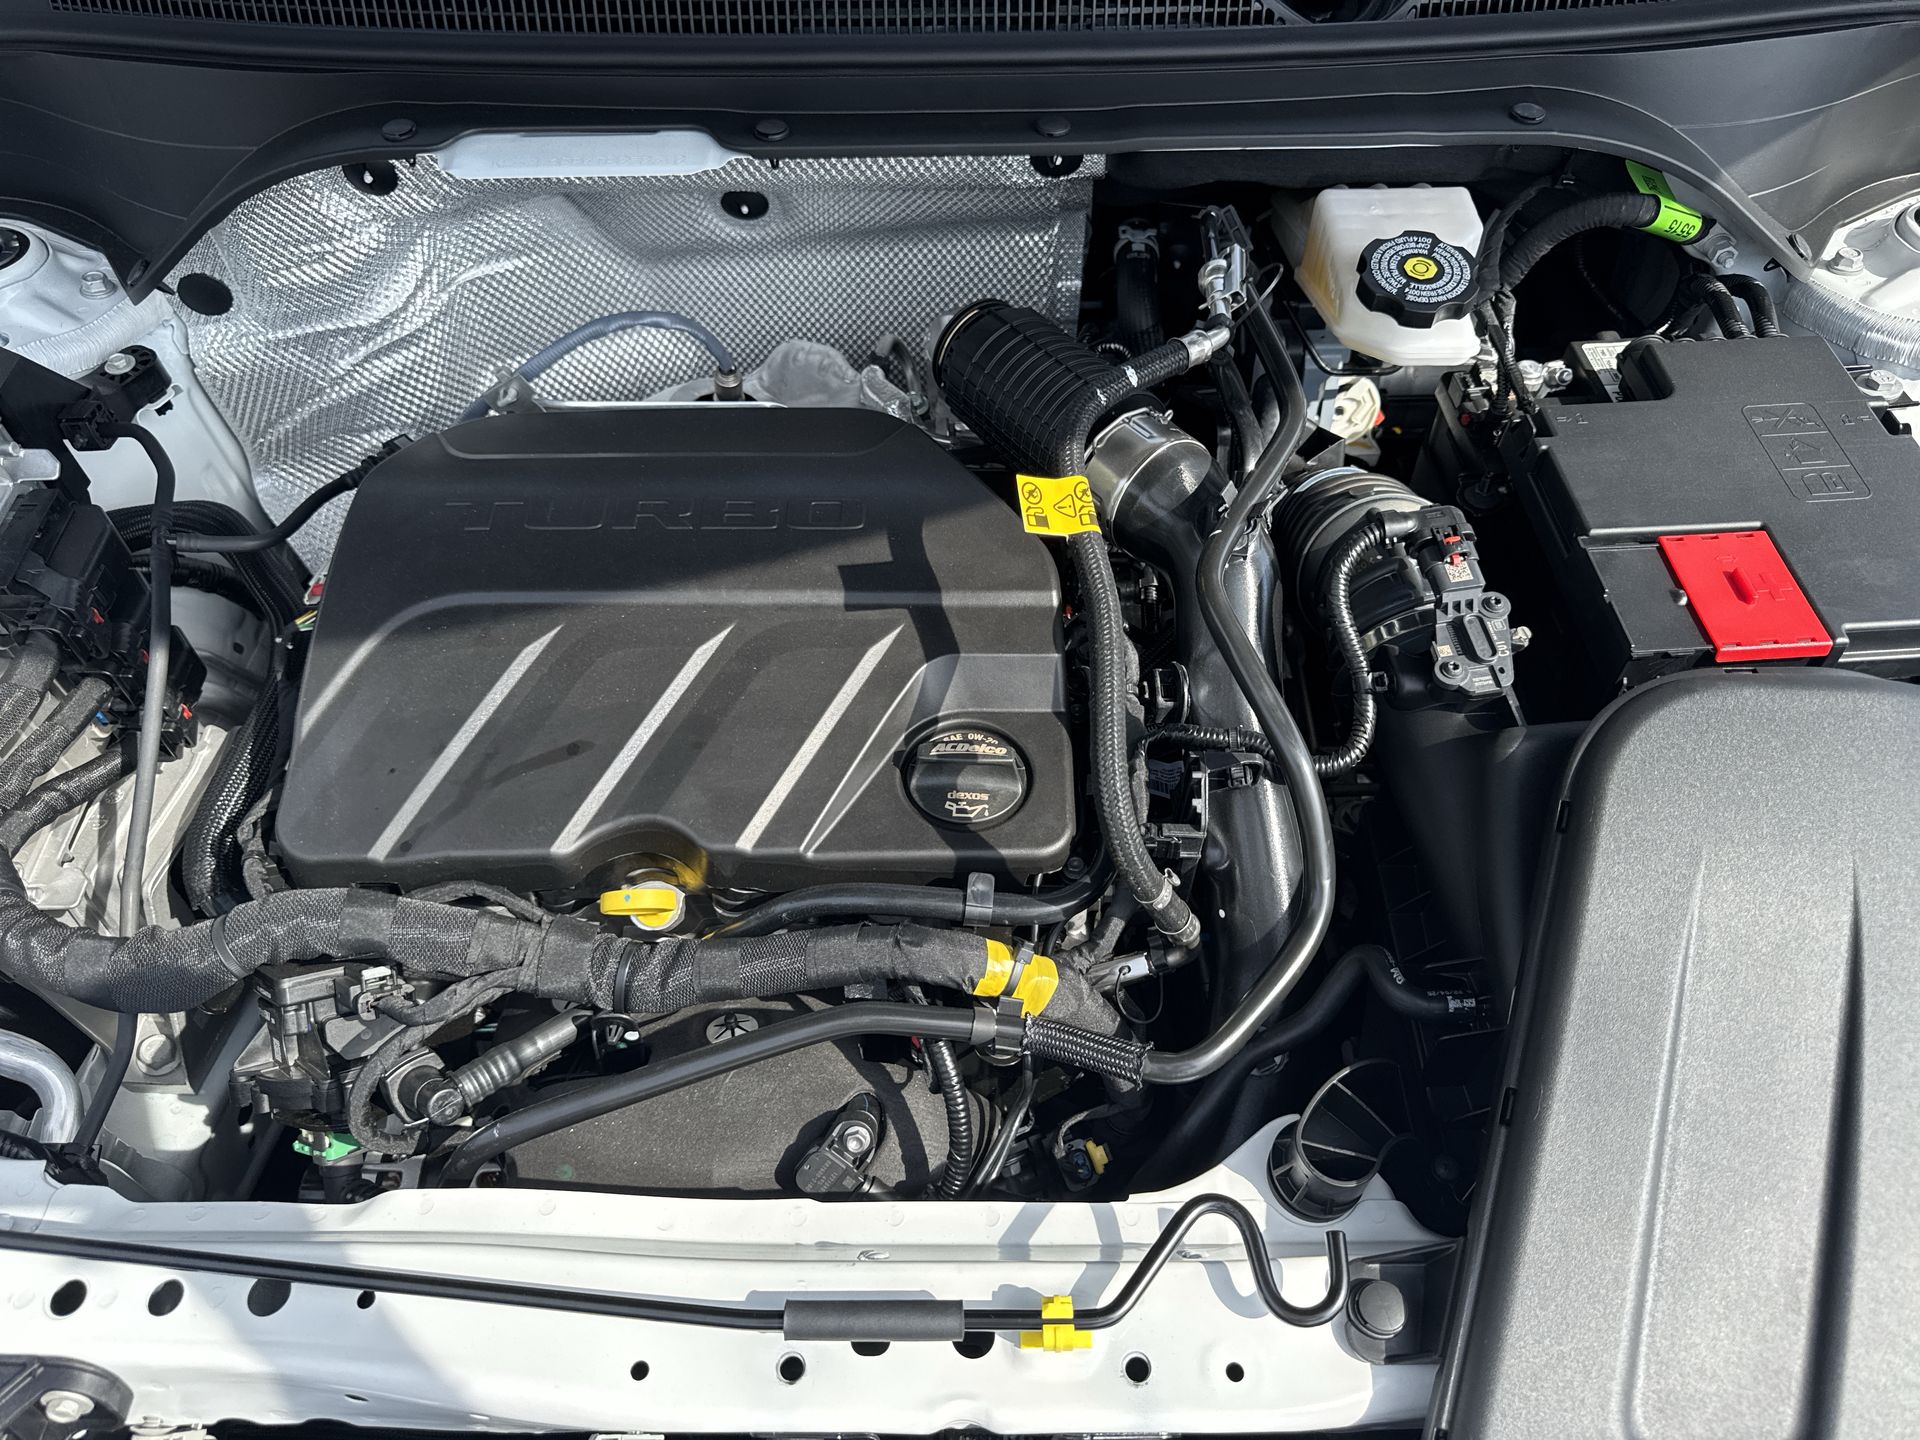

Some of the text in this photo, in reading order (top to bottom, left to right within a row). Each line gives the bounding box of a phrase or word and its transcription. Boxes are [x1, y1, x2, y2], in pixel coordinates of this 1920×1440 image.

[445, 499, 866, 531] TURBO
[930, 742, 1008, 755] ACDelco
[947, 790, 990, 801] dexos
